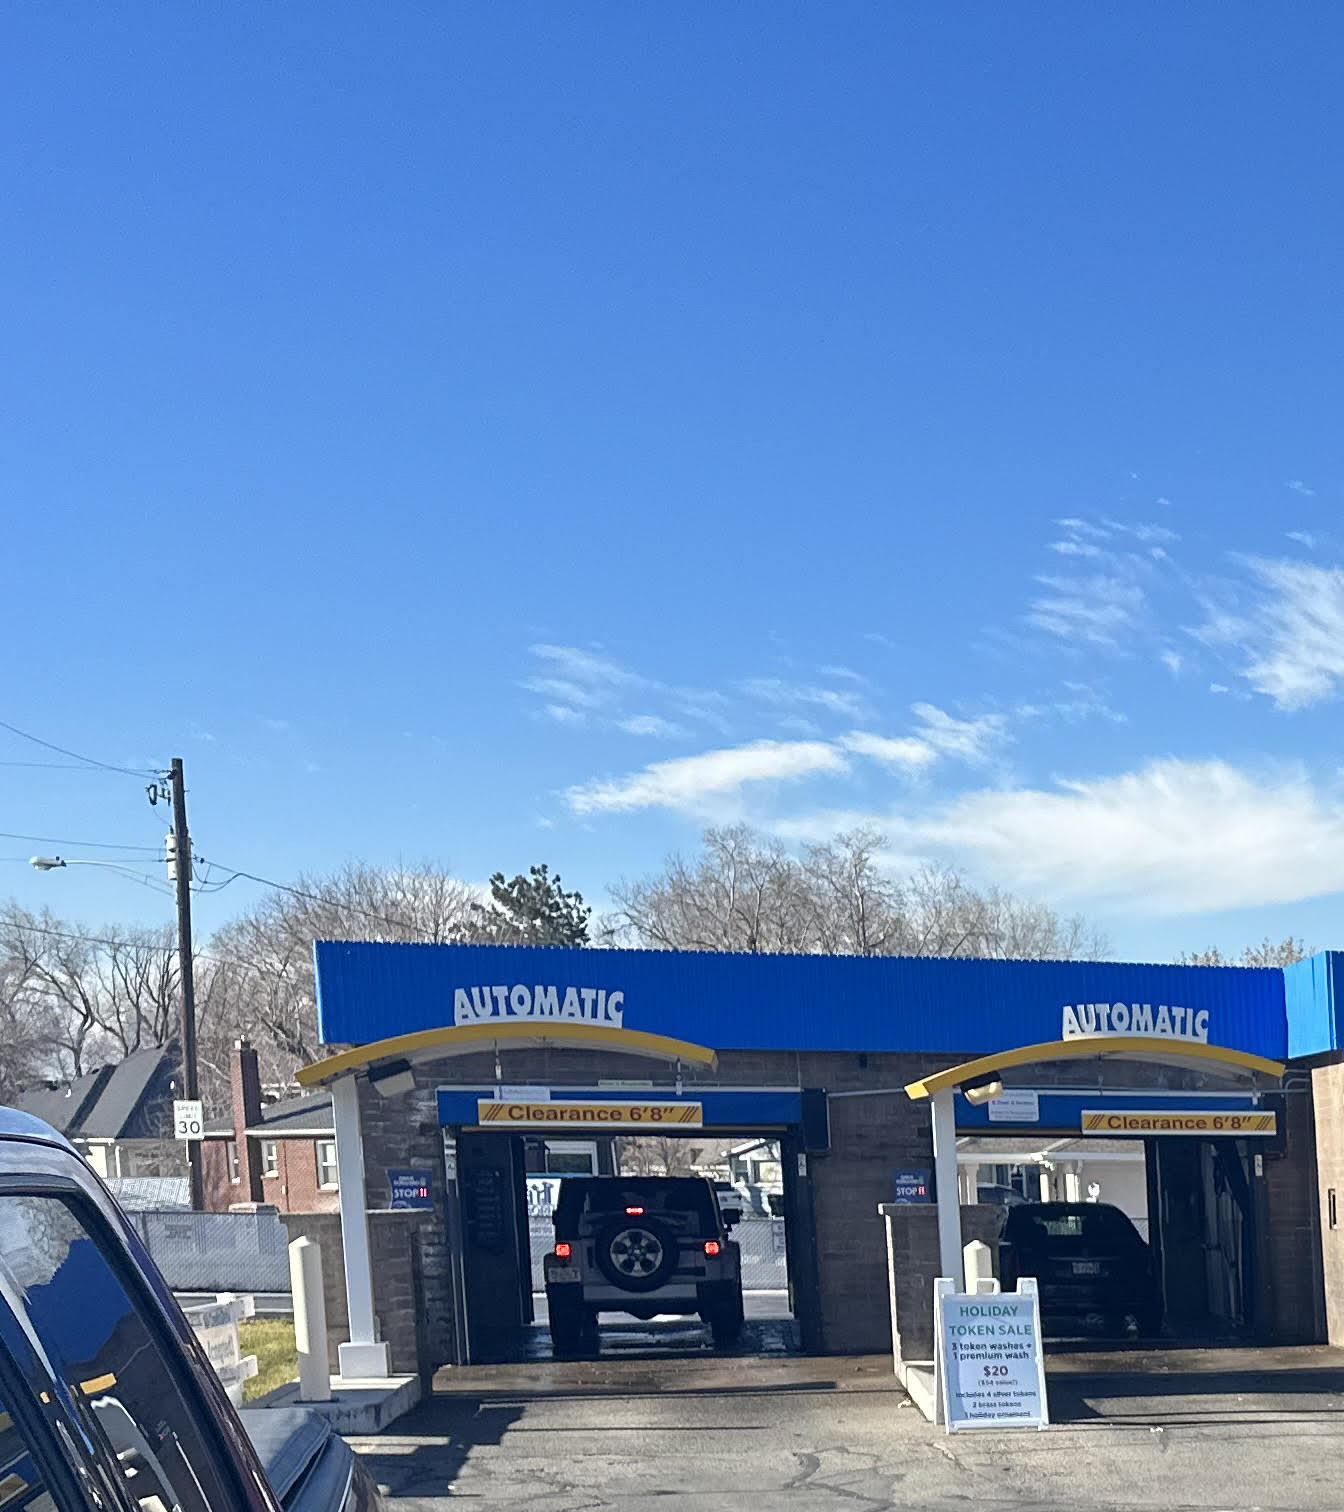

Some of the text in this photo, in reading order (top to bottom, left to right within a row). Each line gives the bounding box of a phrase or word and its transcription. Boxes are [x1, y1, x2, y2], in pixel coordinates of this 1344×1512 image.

[454, 984, 624, 1028] AUTOMATIC
[1062, 1002, 1209, 1044] AUTOMATIC
[508, 1105, 622, 1121] Clearance
[179, 1121, 200, 1134] 30
[1107, 1115, 1207, 1130] Clearance
[394, 1188, 419, 1198] STOP
[896, 1186, 918, 1196] STOP
[960, 1305, 1018, 1317] HOLIDAY
[949, 1324, 1033, 1336] TOKEN SALE
[952, 1342, 958, 1351] 3
[960, 1342, 987, 1351] token
[989, 1342, 1024, 1351] washes
[953, 1352, 1029, 1361] 1 premium wash
[983, 1365, 1009, 1378] $20
